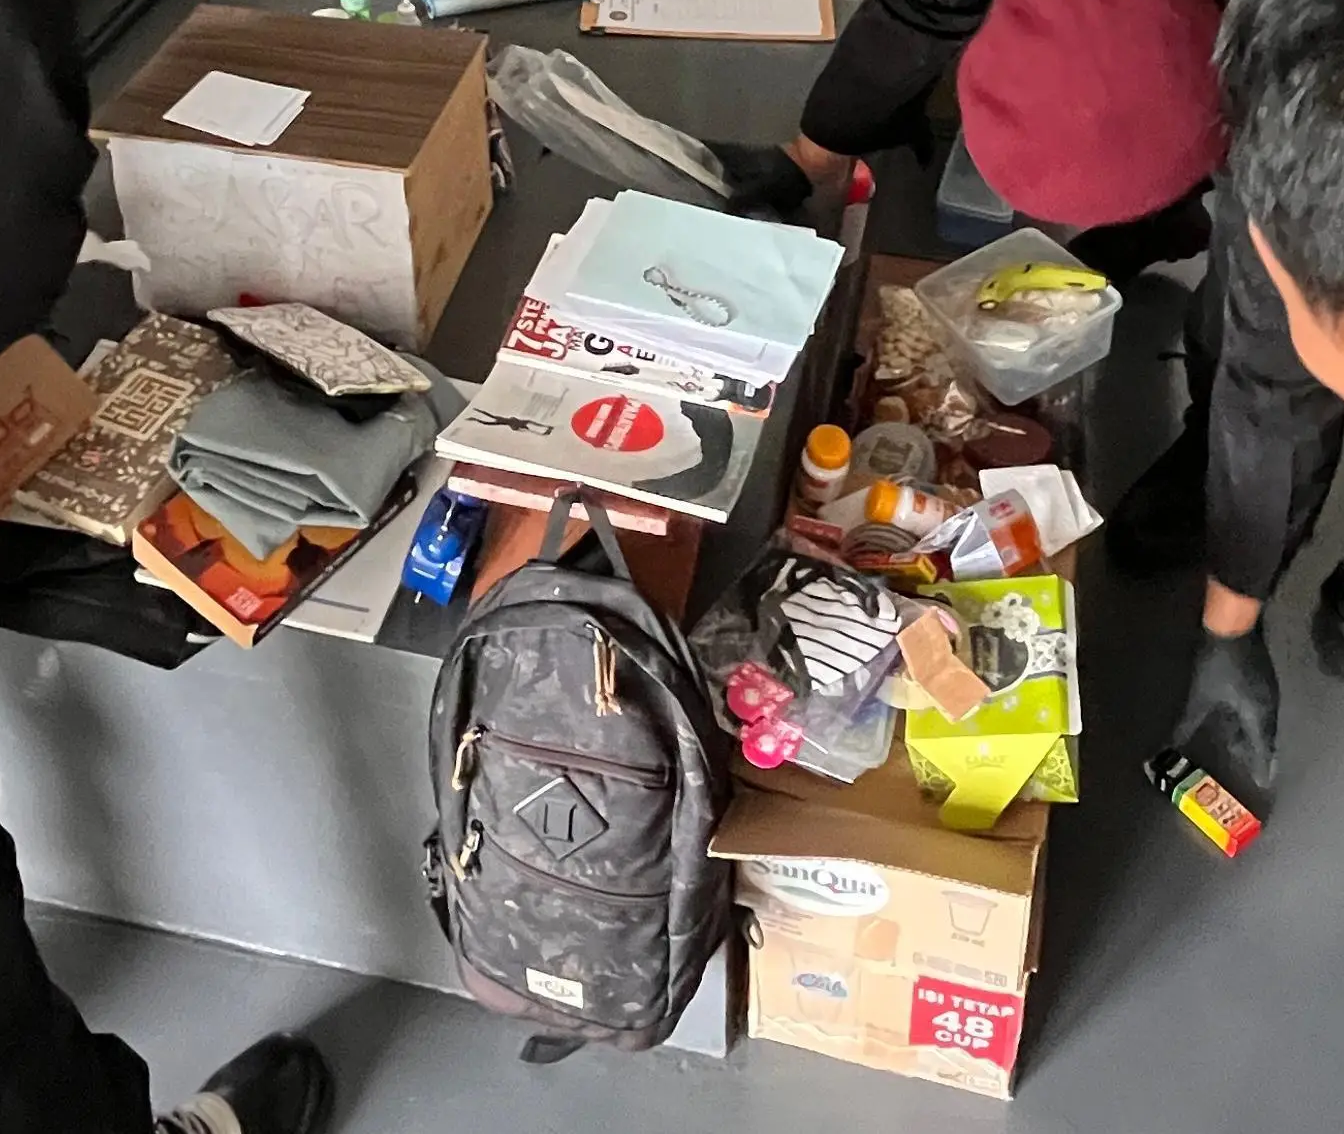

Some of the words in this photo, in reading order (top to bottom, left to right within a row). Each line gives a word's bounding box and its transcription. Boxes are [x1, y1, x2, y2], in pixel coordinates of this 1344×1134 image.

[507, 329, 543, 351] 7
[917, 987, 945, 1005] ISI
[949, 994, 1016, 1017] TETAP
[931, 1010, 994, 1039] 48
[933, 1029, 990, 1050] CUP
